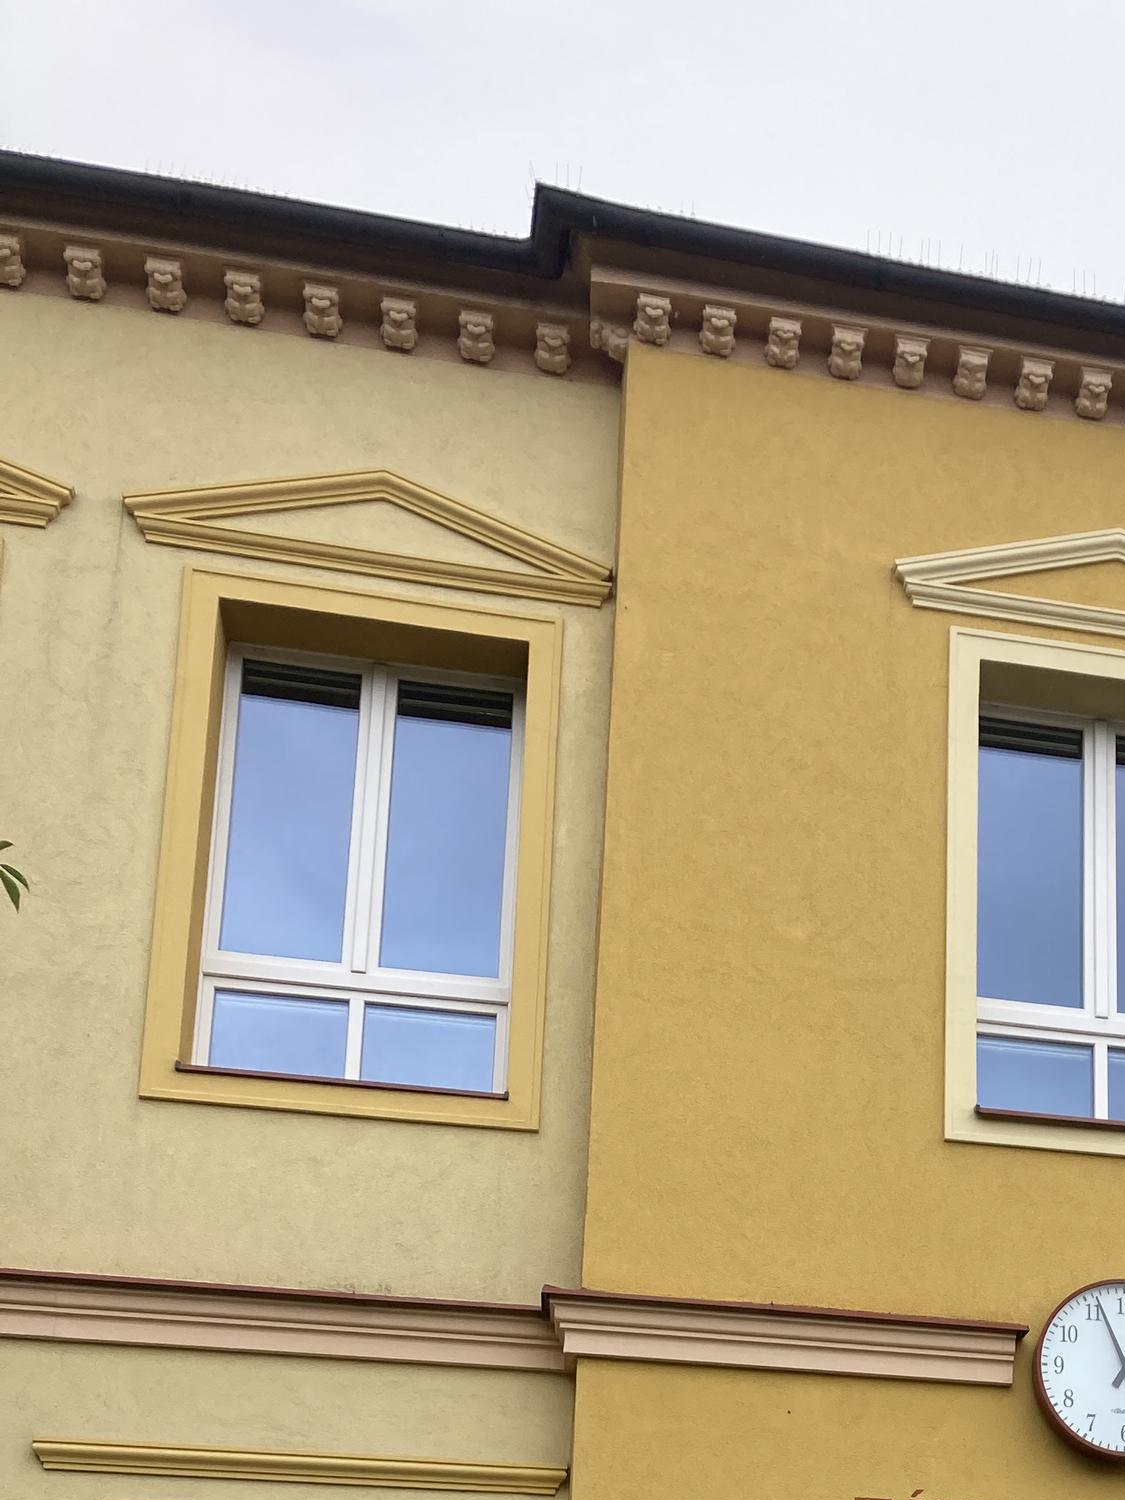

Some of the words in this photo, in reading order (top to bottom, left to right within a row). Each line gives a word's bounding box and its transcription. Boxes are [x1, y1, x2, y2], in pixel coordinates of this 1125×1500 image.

[1085, 1303, 1102, 1321] 11
[1060, 1324, 1078, 1343] 10
[1053, 1356, 1064, 1374] 9
[1063, 1389, 1074, 1408] 8
[1086, 1414, 1096, 1432] 7
